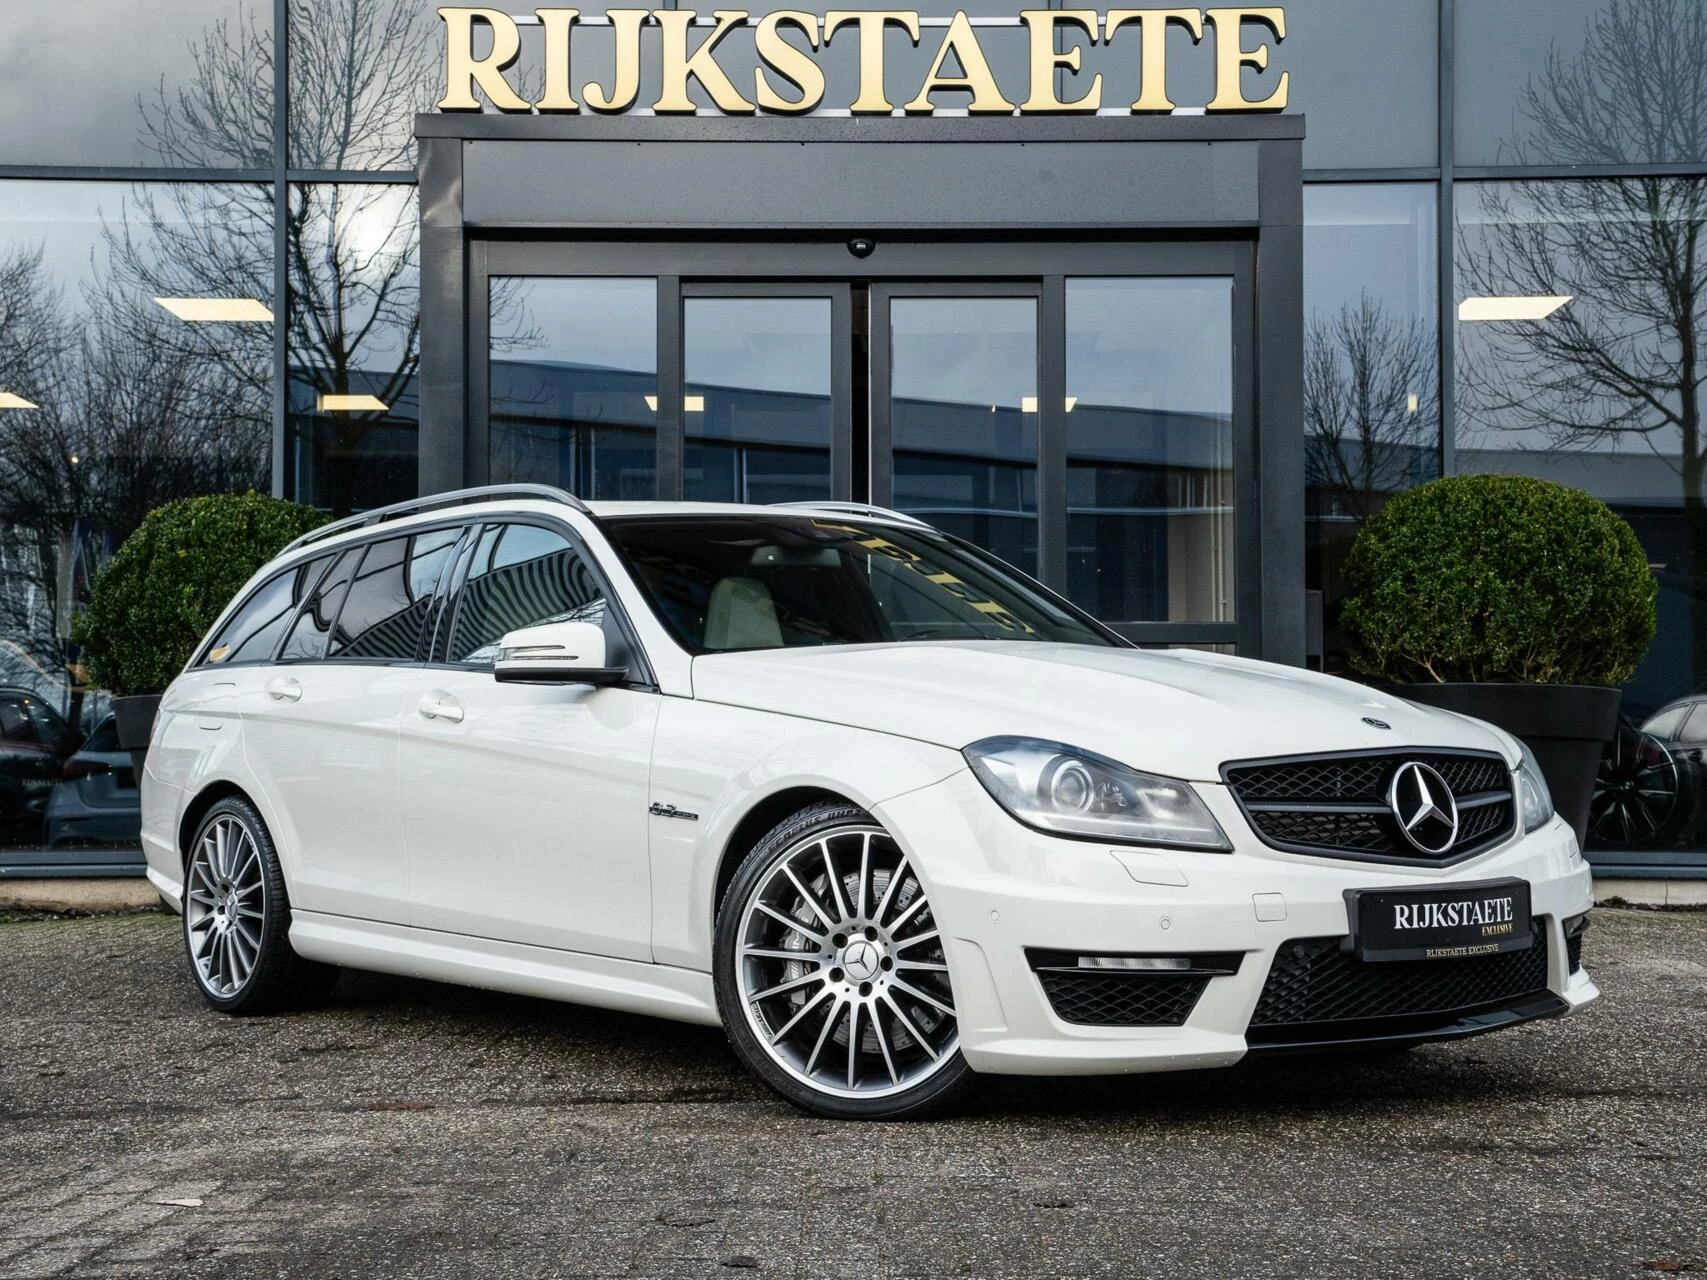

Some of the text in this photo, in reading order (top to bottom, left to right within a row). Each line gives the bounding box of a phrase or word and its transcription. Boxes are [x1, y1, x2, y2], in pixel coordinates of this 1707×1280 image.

[438, 7, 1290, 114] RIJKSTAETE
[1394, 897, 1513, 929] RIJKSTAETE
[1482, 923, 1513, 936] EXCLUSIVE
[1426, 944, 1499, 958] RIJKSTAETE EXCLUSIVE
